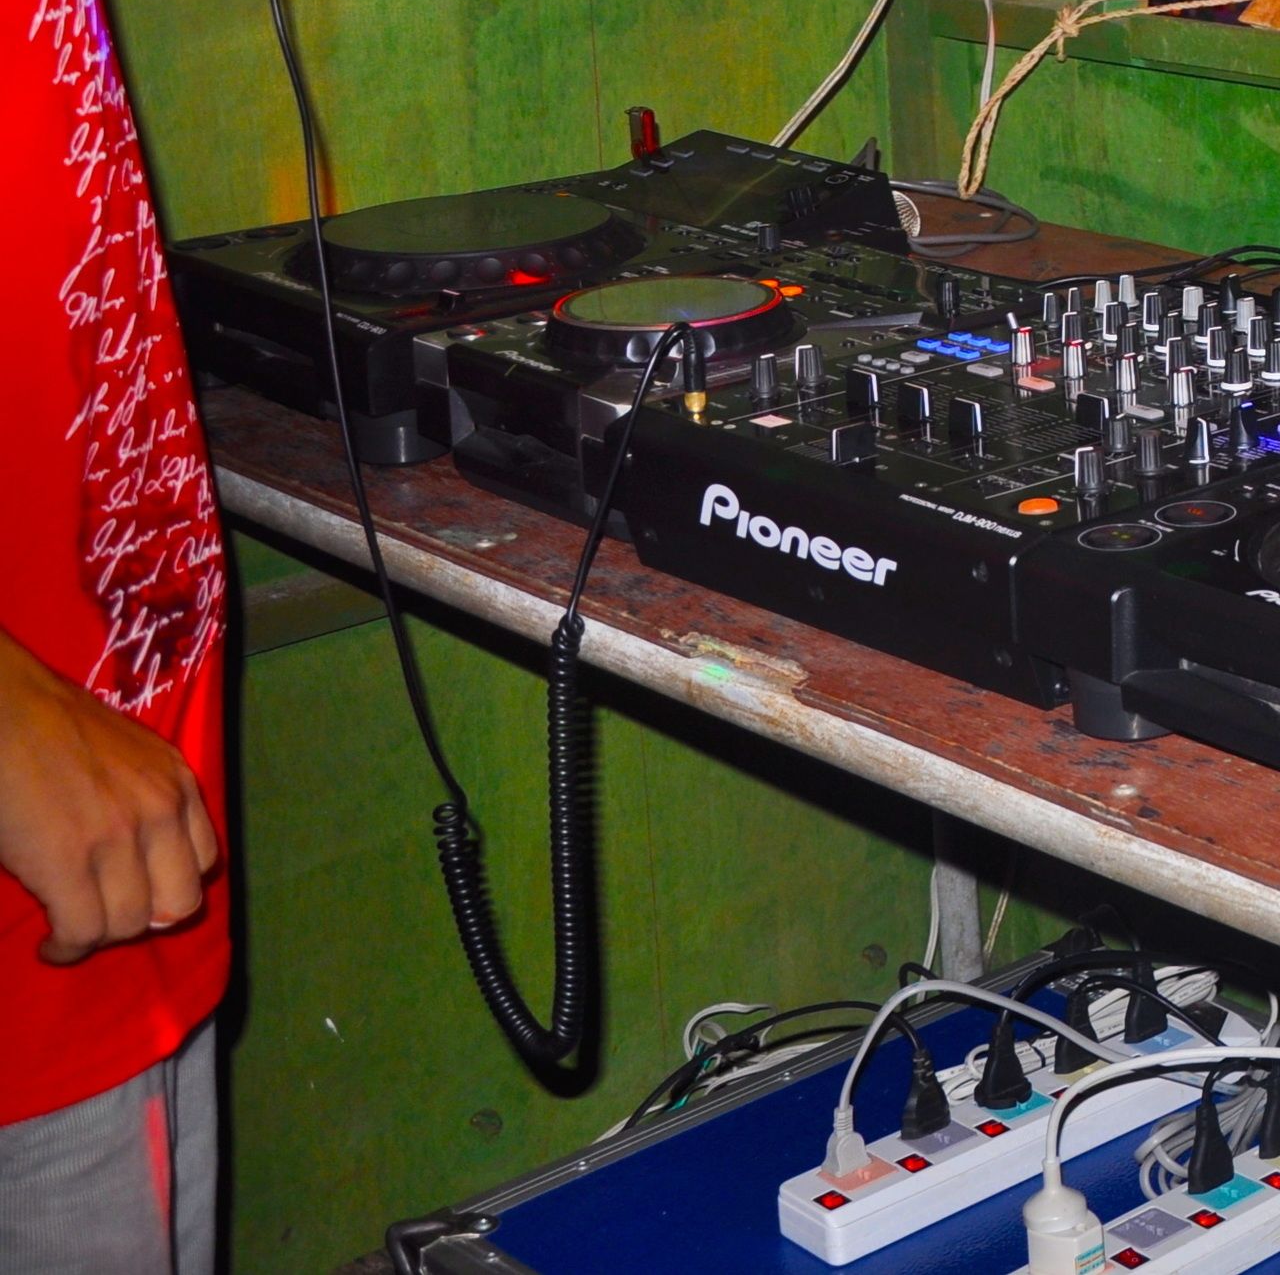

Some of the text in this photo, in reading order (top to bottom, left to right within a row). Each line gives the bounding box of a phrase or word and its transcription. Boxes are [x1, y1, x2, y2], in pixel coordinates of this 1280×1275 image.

[700, 483, 898, 586] Pioneer
[952, 511, 996, 532] DJM-900
[995, 524, 1023, 539] nexus
